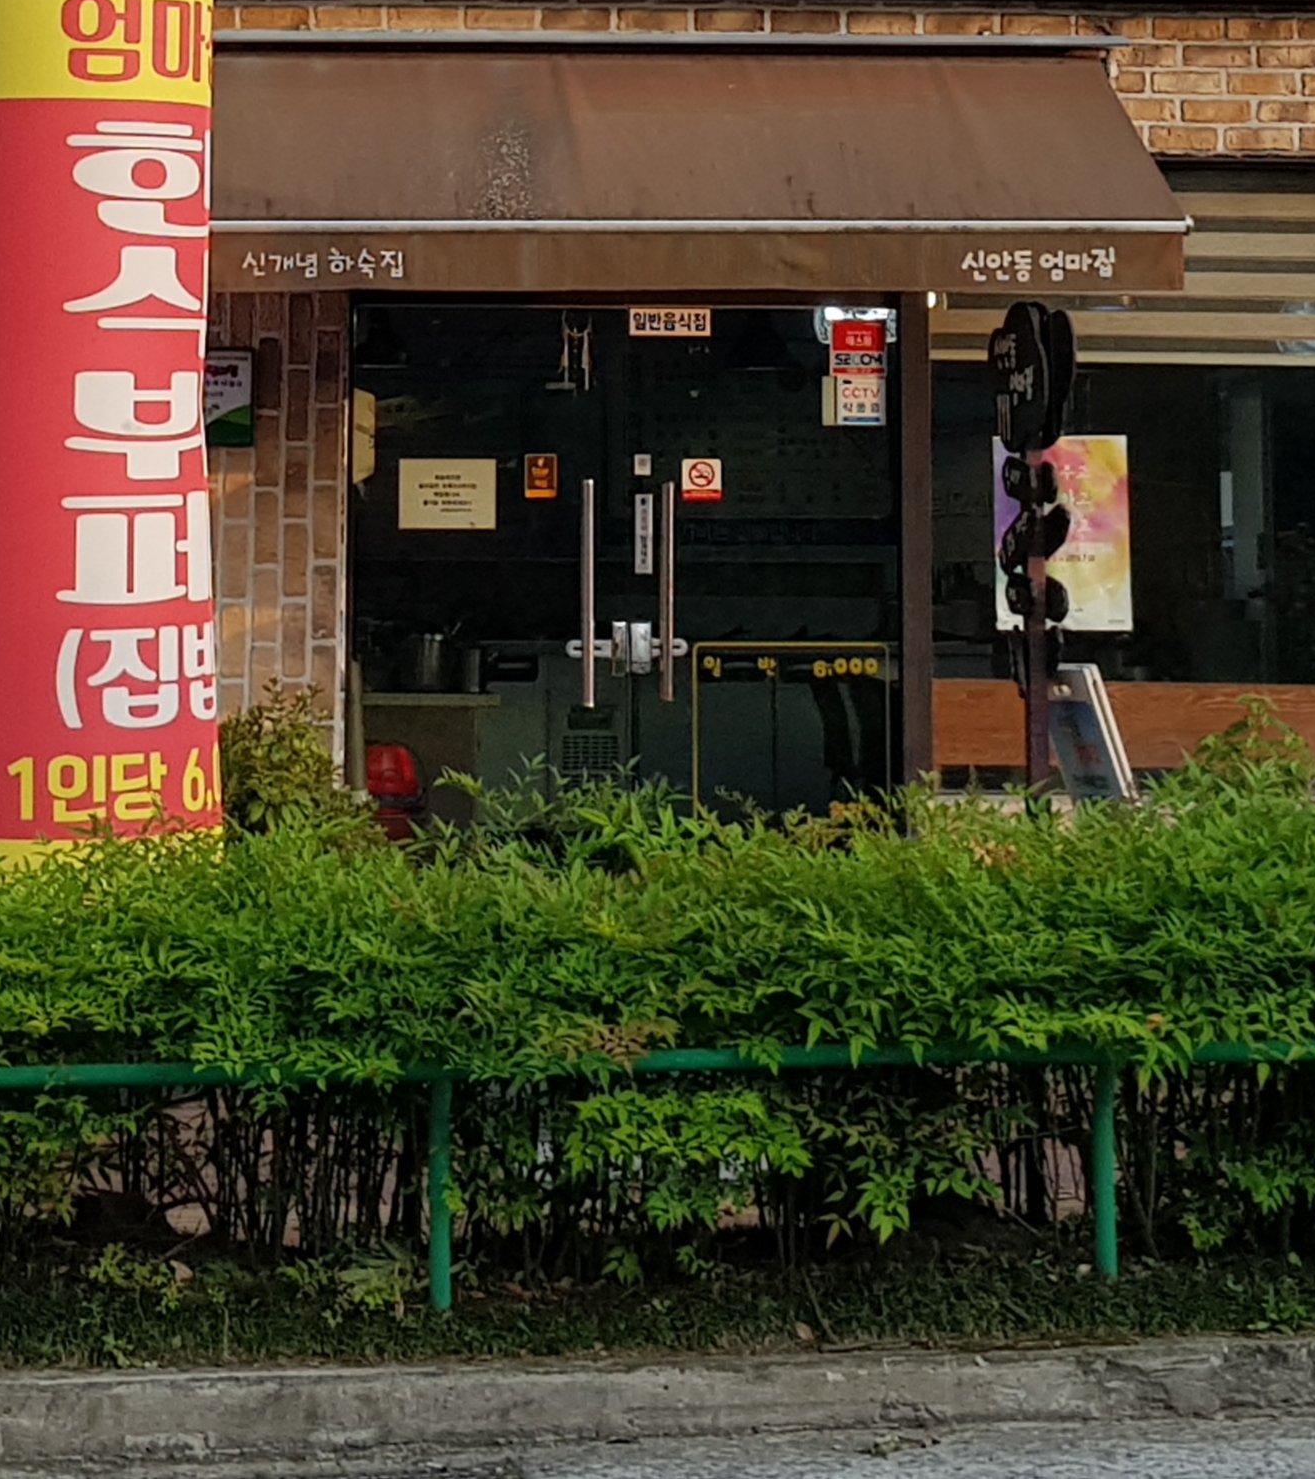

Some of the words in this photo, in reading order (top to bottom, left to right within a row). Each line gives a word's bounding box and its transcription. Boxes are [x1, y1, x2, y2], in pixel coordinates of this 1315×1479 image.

[242, 250, 319, 278] 신개념
[328, 248, 405, 278] 하숙집
[961, 249, 1032, 282] 신안동
[1039, 247, 1116, 282] 엄마집
[633, 312, 706, 331] 일반음식점
[842, 387, 880, 399] CCTV
[7, 752, 169, 823] 1인당
